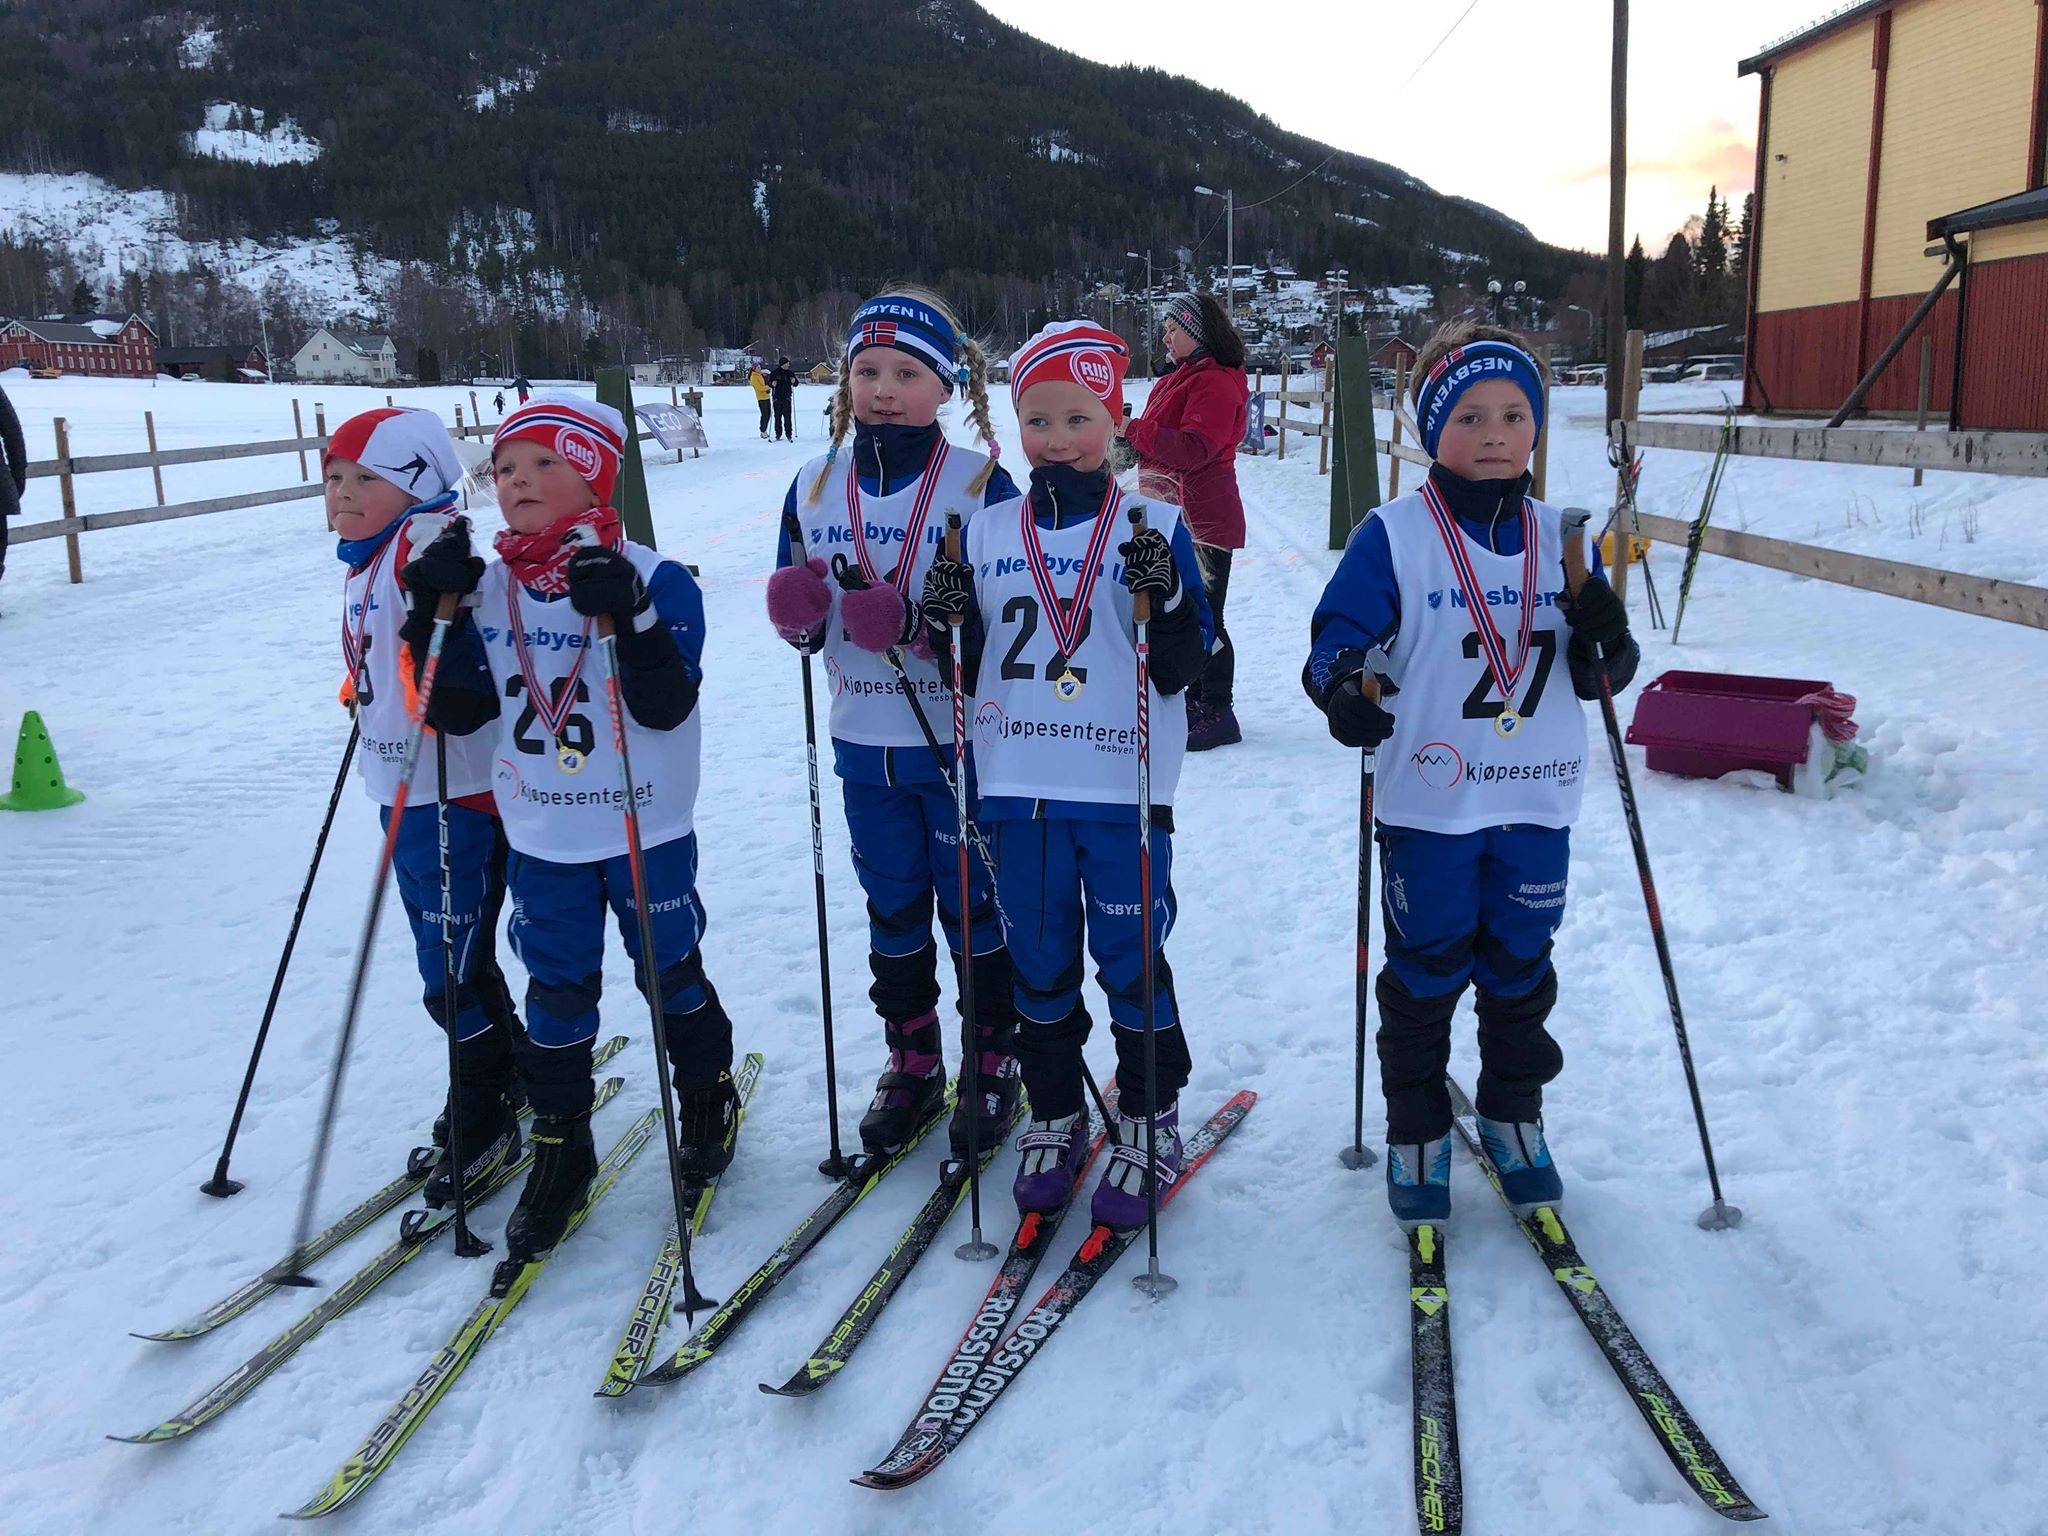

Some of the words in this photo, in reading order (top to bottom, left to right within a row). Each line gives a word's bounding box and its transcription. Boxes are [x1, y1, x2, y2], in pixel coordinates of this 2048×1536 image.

[920, 311, 934, 327] IL
[1080, 361, 1109, 380] RIIS
[1430, 357, 1513, 414] NESBYEN
[566, 439, 595, 465] RIIS
[1451, 585, 1557, 609] Nsbyen
[1001, 595, 1092, 684] 22
[1461, 629, 1557, 720] 27
[505, 673, 596, 757] 26
[1095, 742, 1135, 756] nesbyen
[521, 780, 654, 806] kjøpesenteet
[682, 893, 692, 905] IL
[463, 1132, 509, 1184] FISCHER
[1030, 1134, 1070, 1144] FROST
[1119, 1148, 1149, 1165] FROS
[621, 1262, 673, 1357] FISCHER
[698, 1259, 779, 1342] FISCHER
[824, 1268, 891, 1353] FISCHER
[916, 1297, 1017, 1430] ROSSIGNOL
[354, 1346, 457, 1463] FISCHER
[1420, 1414, 1444, 1532] FISCHER
[1639, 1391, 1736, 1505] FISCHER
